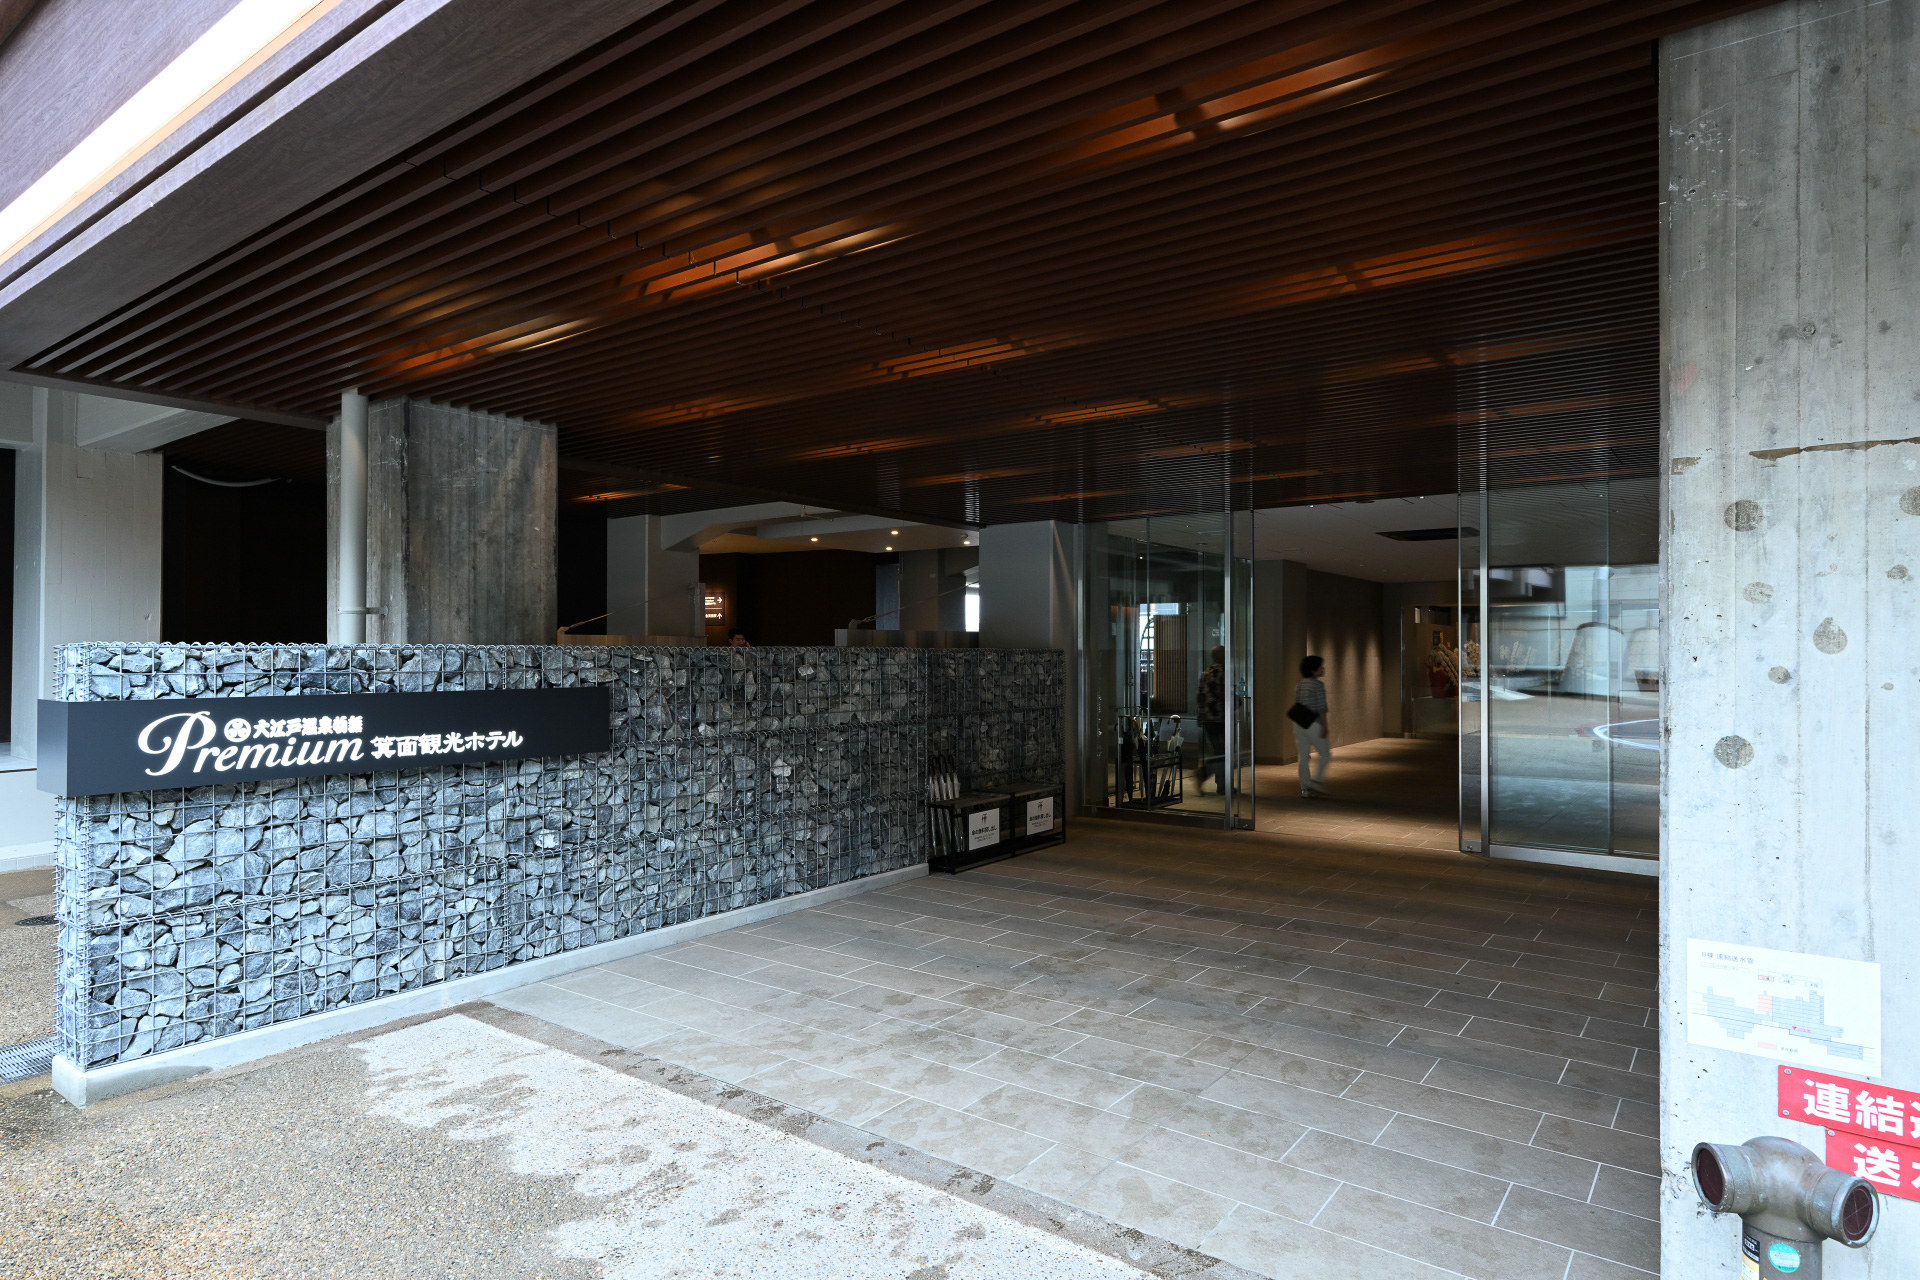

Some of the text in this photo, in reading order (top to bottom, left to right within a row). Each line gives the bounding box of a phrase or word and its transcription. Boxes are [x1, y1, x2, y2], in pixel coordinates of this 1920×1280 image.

[138, 710, 364, 777] Premium
[370, 730, 524, 759] 箕面観光ホテル
